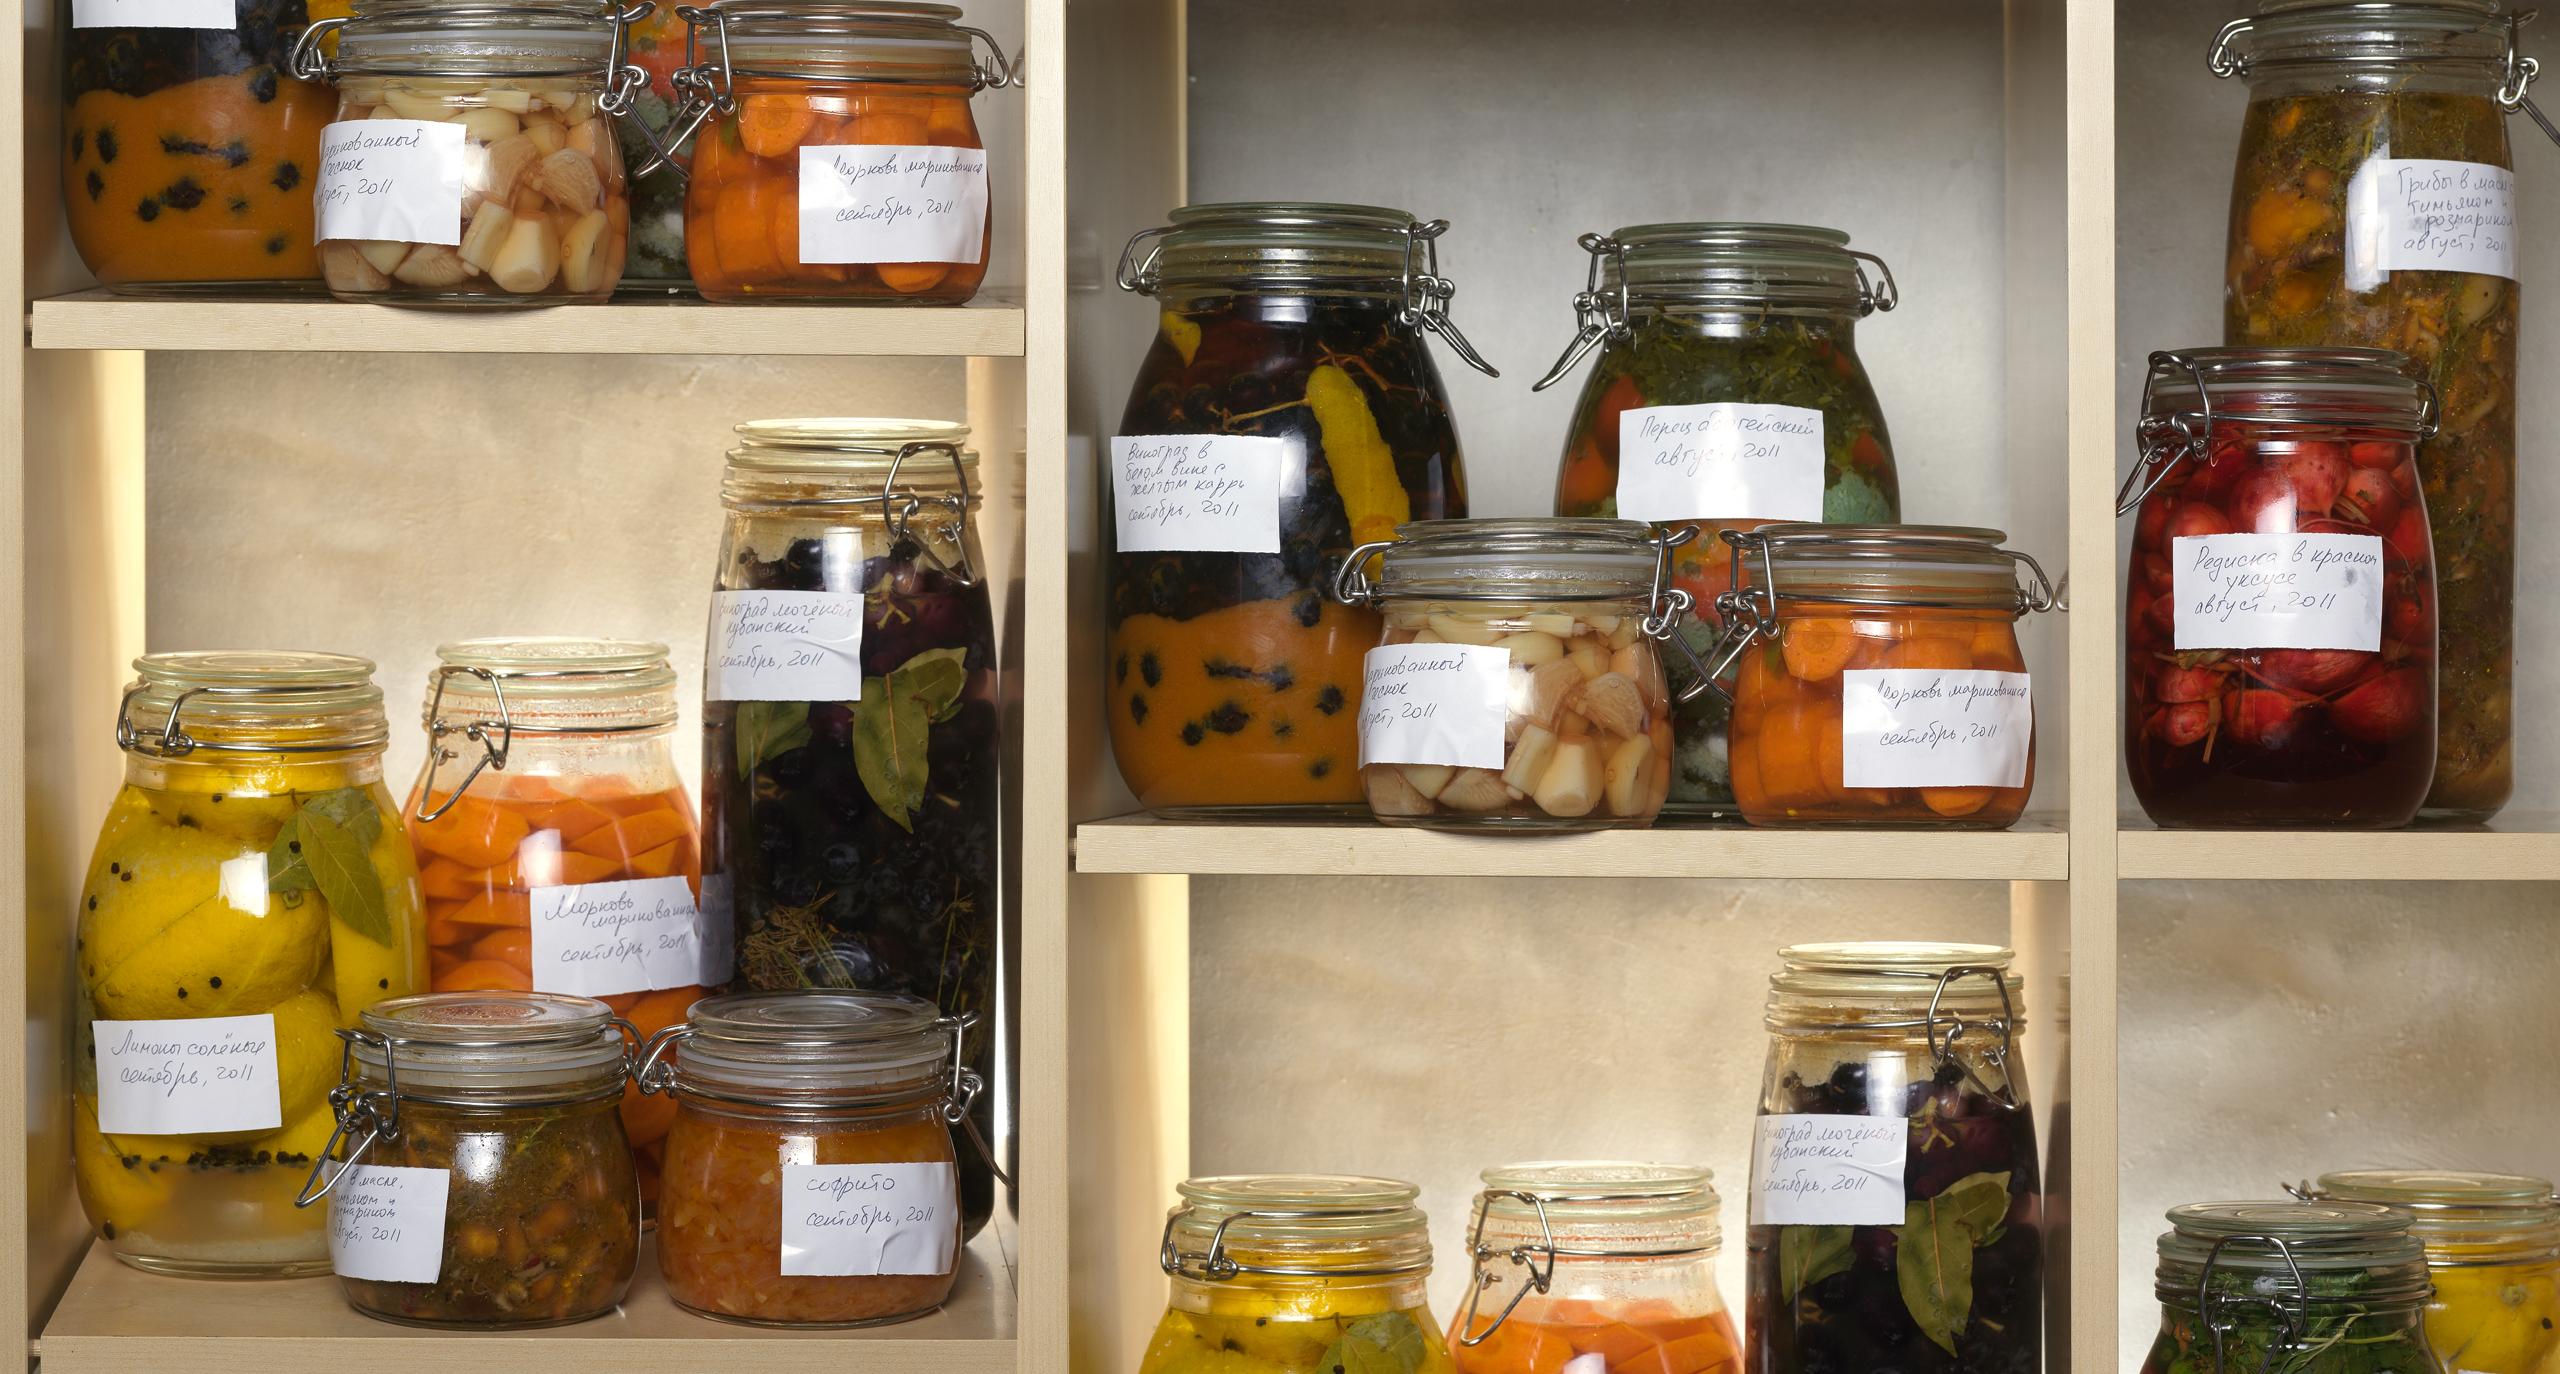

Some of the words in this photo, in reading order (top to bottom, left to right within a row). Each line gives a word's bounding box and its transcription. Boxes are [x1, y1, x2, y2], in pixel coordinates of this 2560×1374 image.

[357, 178, 394, 195] 2011
[2460, 168, 2470, 189] в
[926, 199, 953, 215] 2011
[2485, 236, 2507, 252] 2011
[1639, 415, 1692, 443] Перец
[1743, 443, 1780, 459] 2011
[1201, 500, 1240, 517] 2011
[2223, 572, 2297, 599] уксусе
[2287, 591, 2337, 610] 2011
[787, 650, 825, 667] 2011
[1401, 702, 1437, 719] 2011
[1970, 722, 1997, 738] 2011
[544, 890, 634, 927] Морковь
[658, 934, 686, 950] 2011
[216, 1063, 254, 1081] 2011
[1831, 1174, 1869, 1191] 2011
[905, 1206, 935, 1222] 2011
[371, 1226, 402, 1242] 2011
